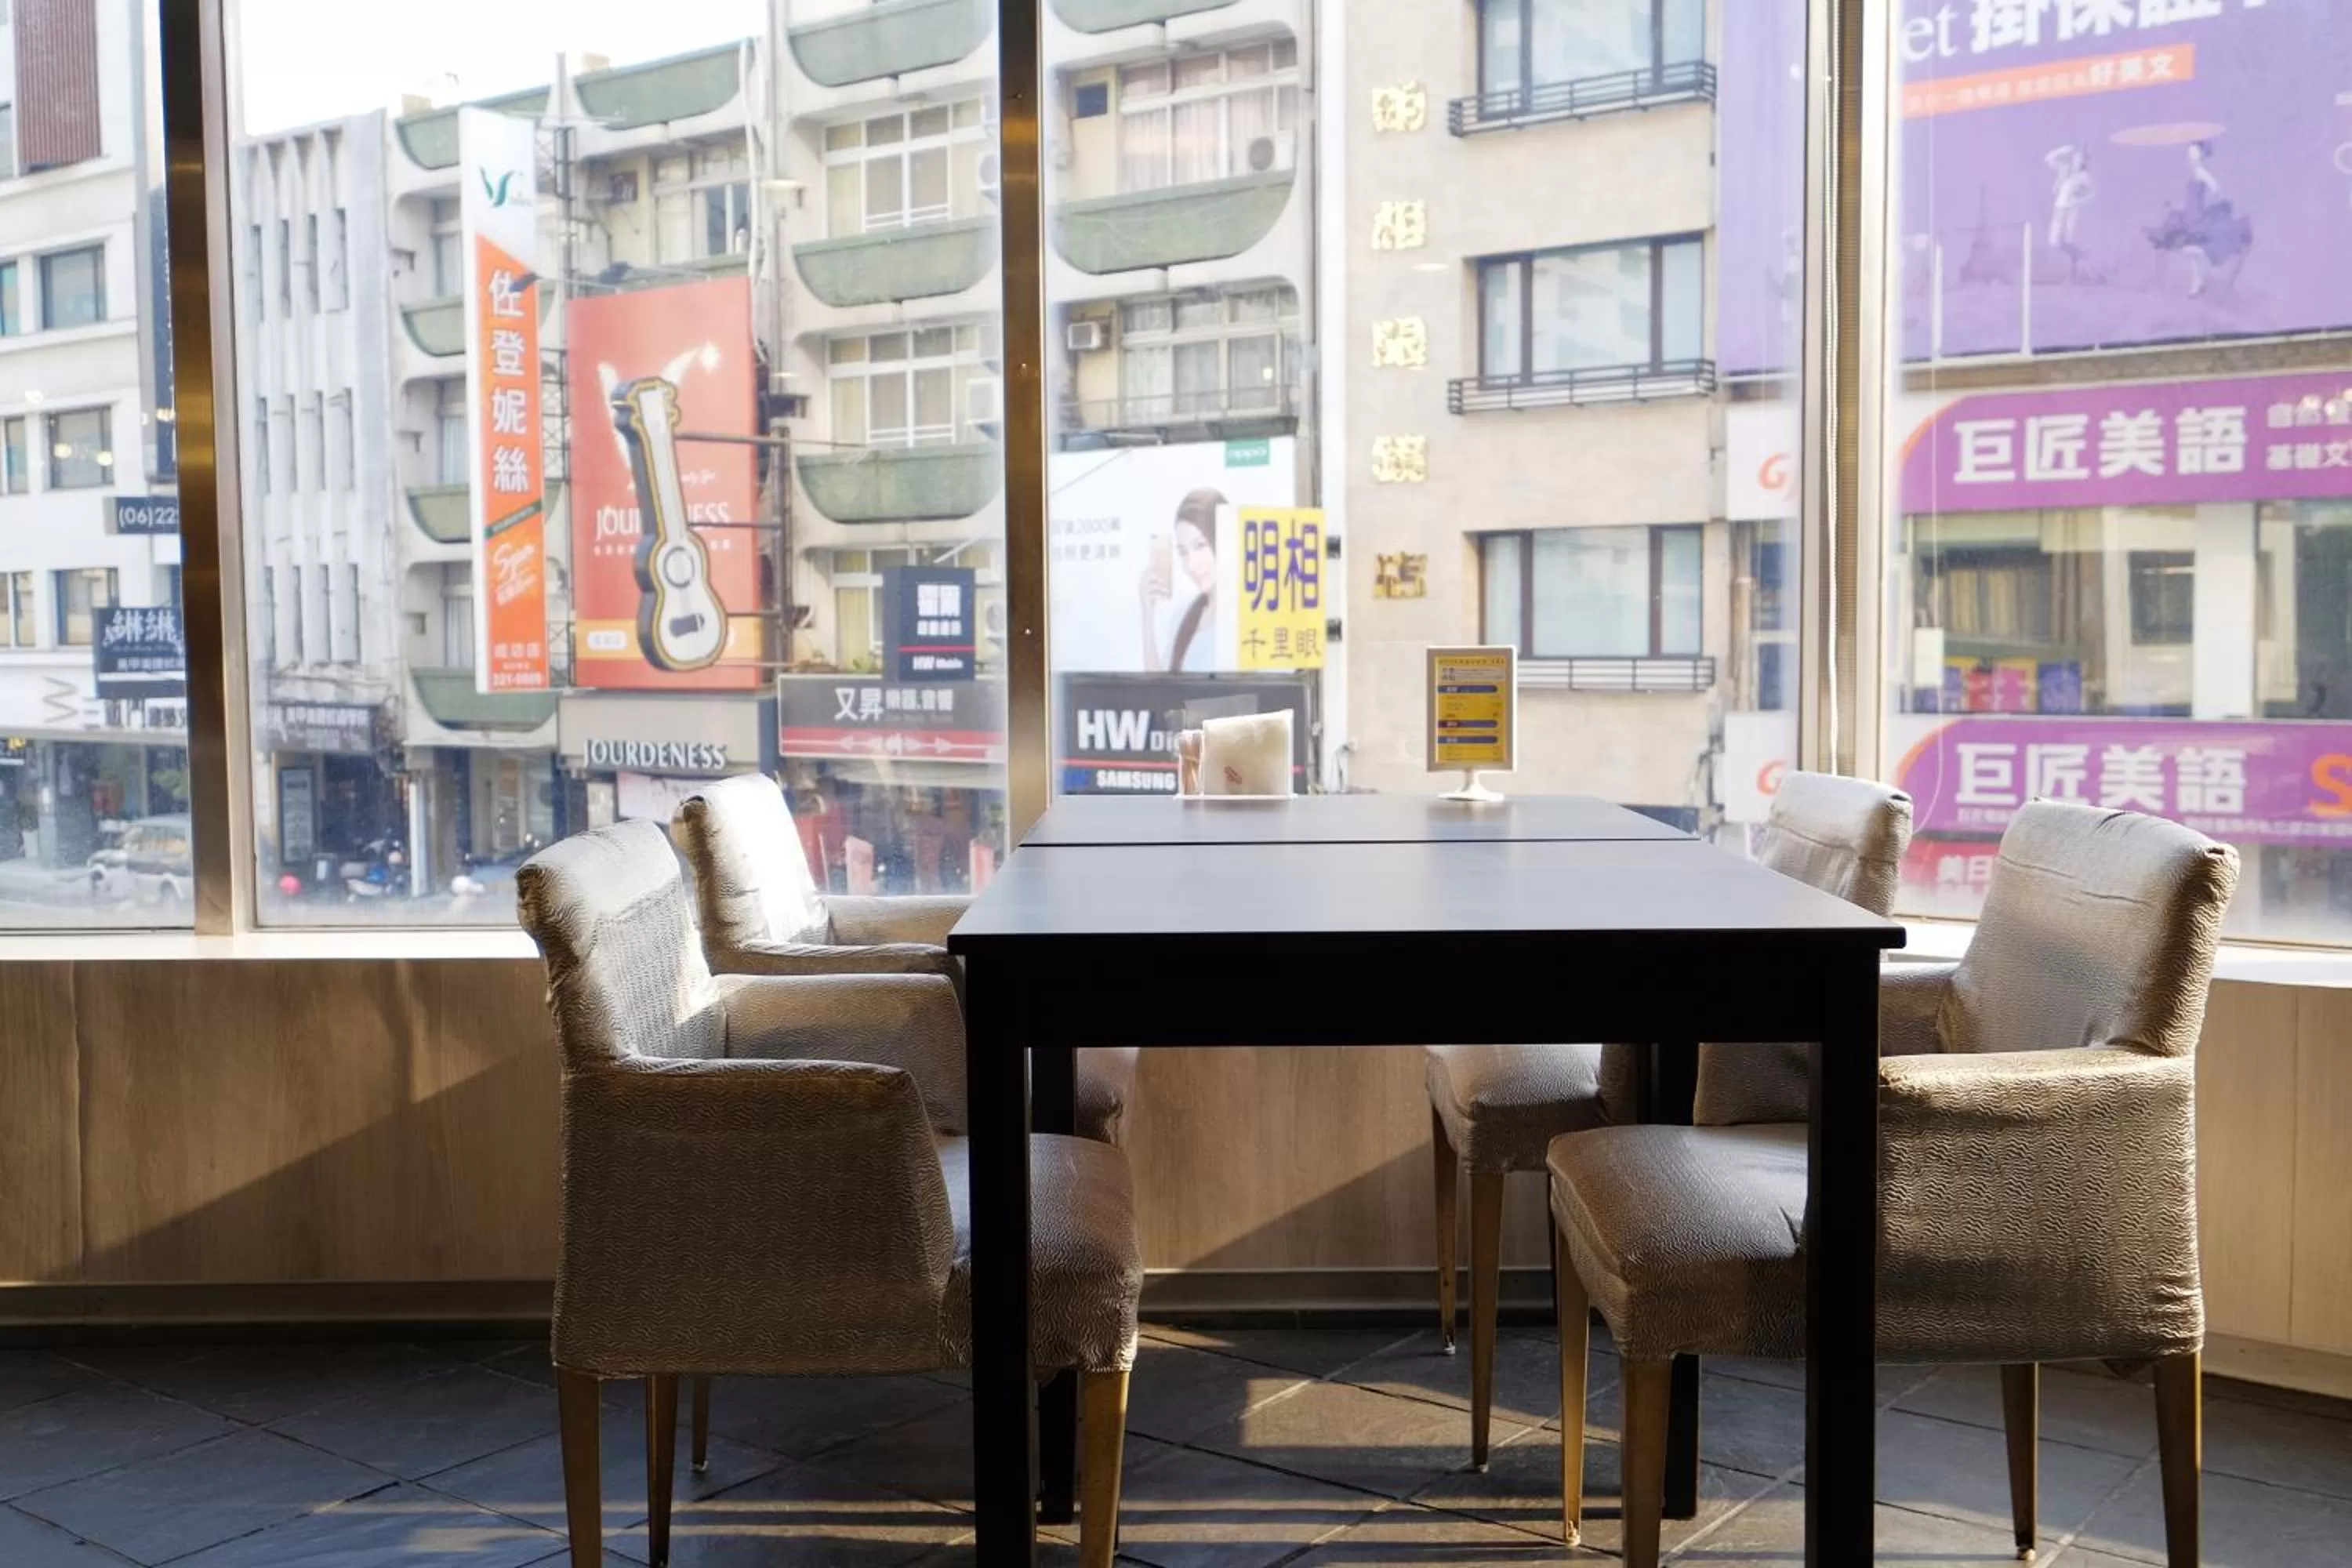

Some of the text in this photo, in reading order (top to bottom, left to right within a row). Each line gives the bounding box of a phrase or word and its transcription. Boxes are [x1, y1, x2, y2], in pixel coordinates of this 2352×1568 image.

[488, 269, 530, 493] 佐登妮絲
[1953, 405, 2249, 484] 巨匠美語
[118, 506, 178, 528] (06)22
[1076, 709, 1150, 750] HW
[583, 739, 728, 770] JOURDENESS
[1096, 770, 1177, 790] SAMSUNG
[1955, 742, 2248, 815] 巨匠美語
